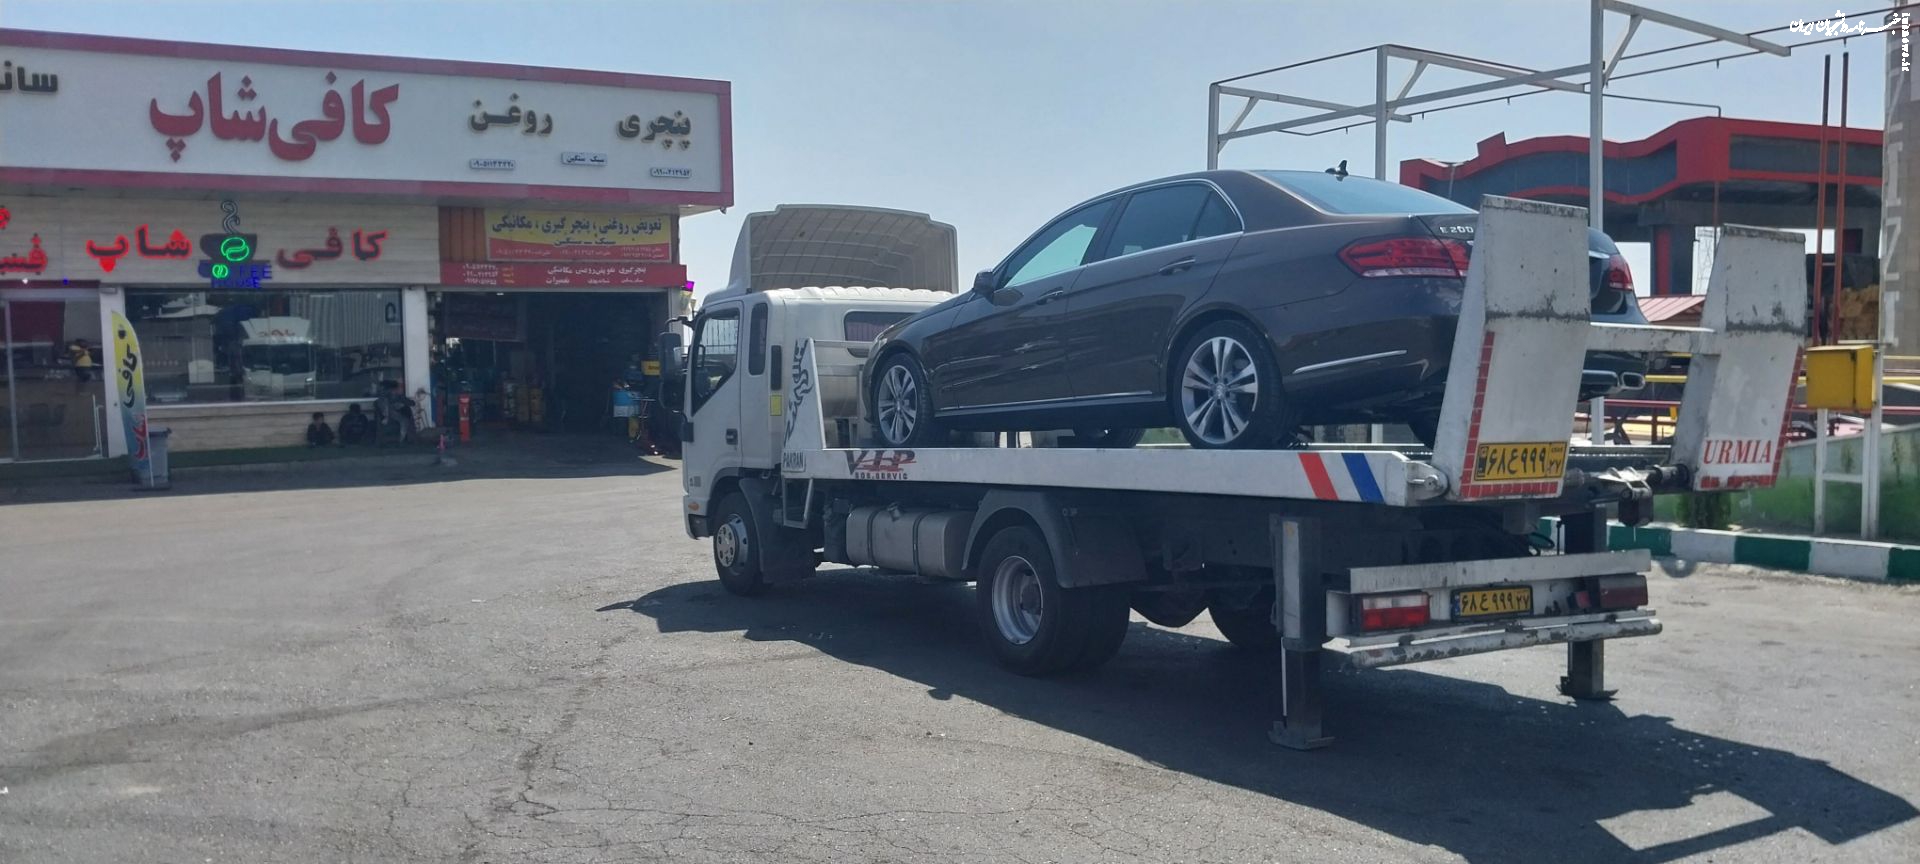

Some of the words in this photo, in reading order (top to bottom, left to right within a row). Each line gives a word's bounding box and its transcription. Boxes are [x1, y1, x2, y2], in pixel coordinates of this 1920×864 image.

[149, 71, 267, 163] شاپ
[268, 70, 400, 162] کافی
[470, 93, 553, 134] روغن
[86, 225, 192, 272] شاپ
[277, 227, 388, 269] کافی
[844, 449, 917, 476] VIP
[1703, 438, 1773, 465] URMIA
